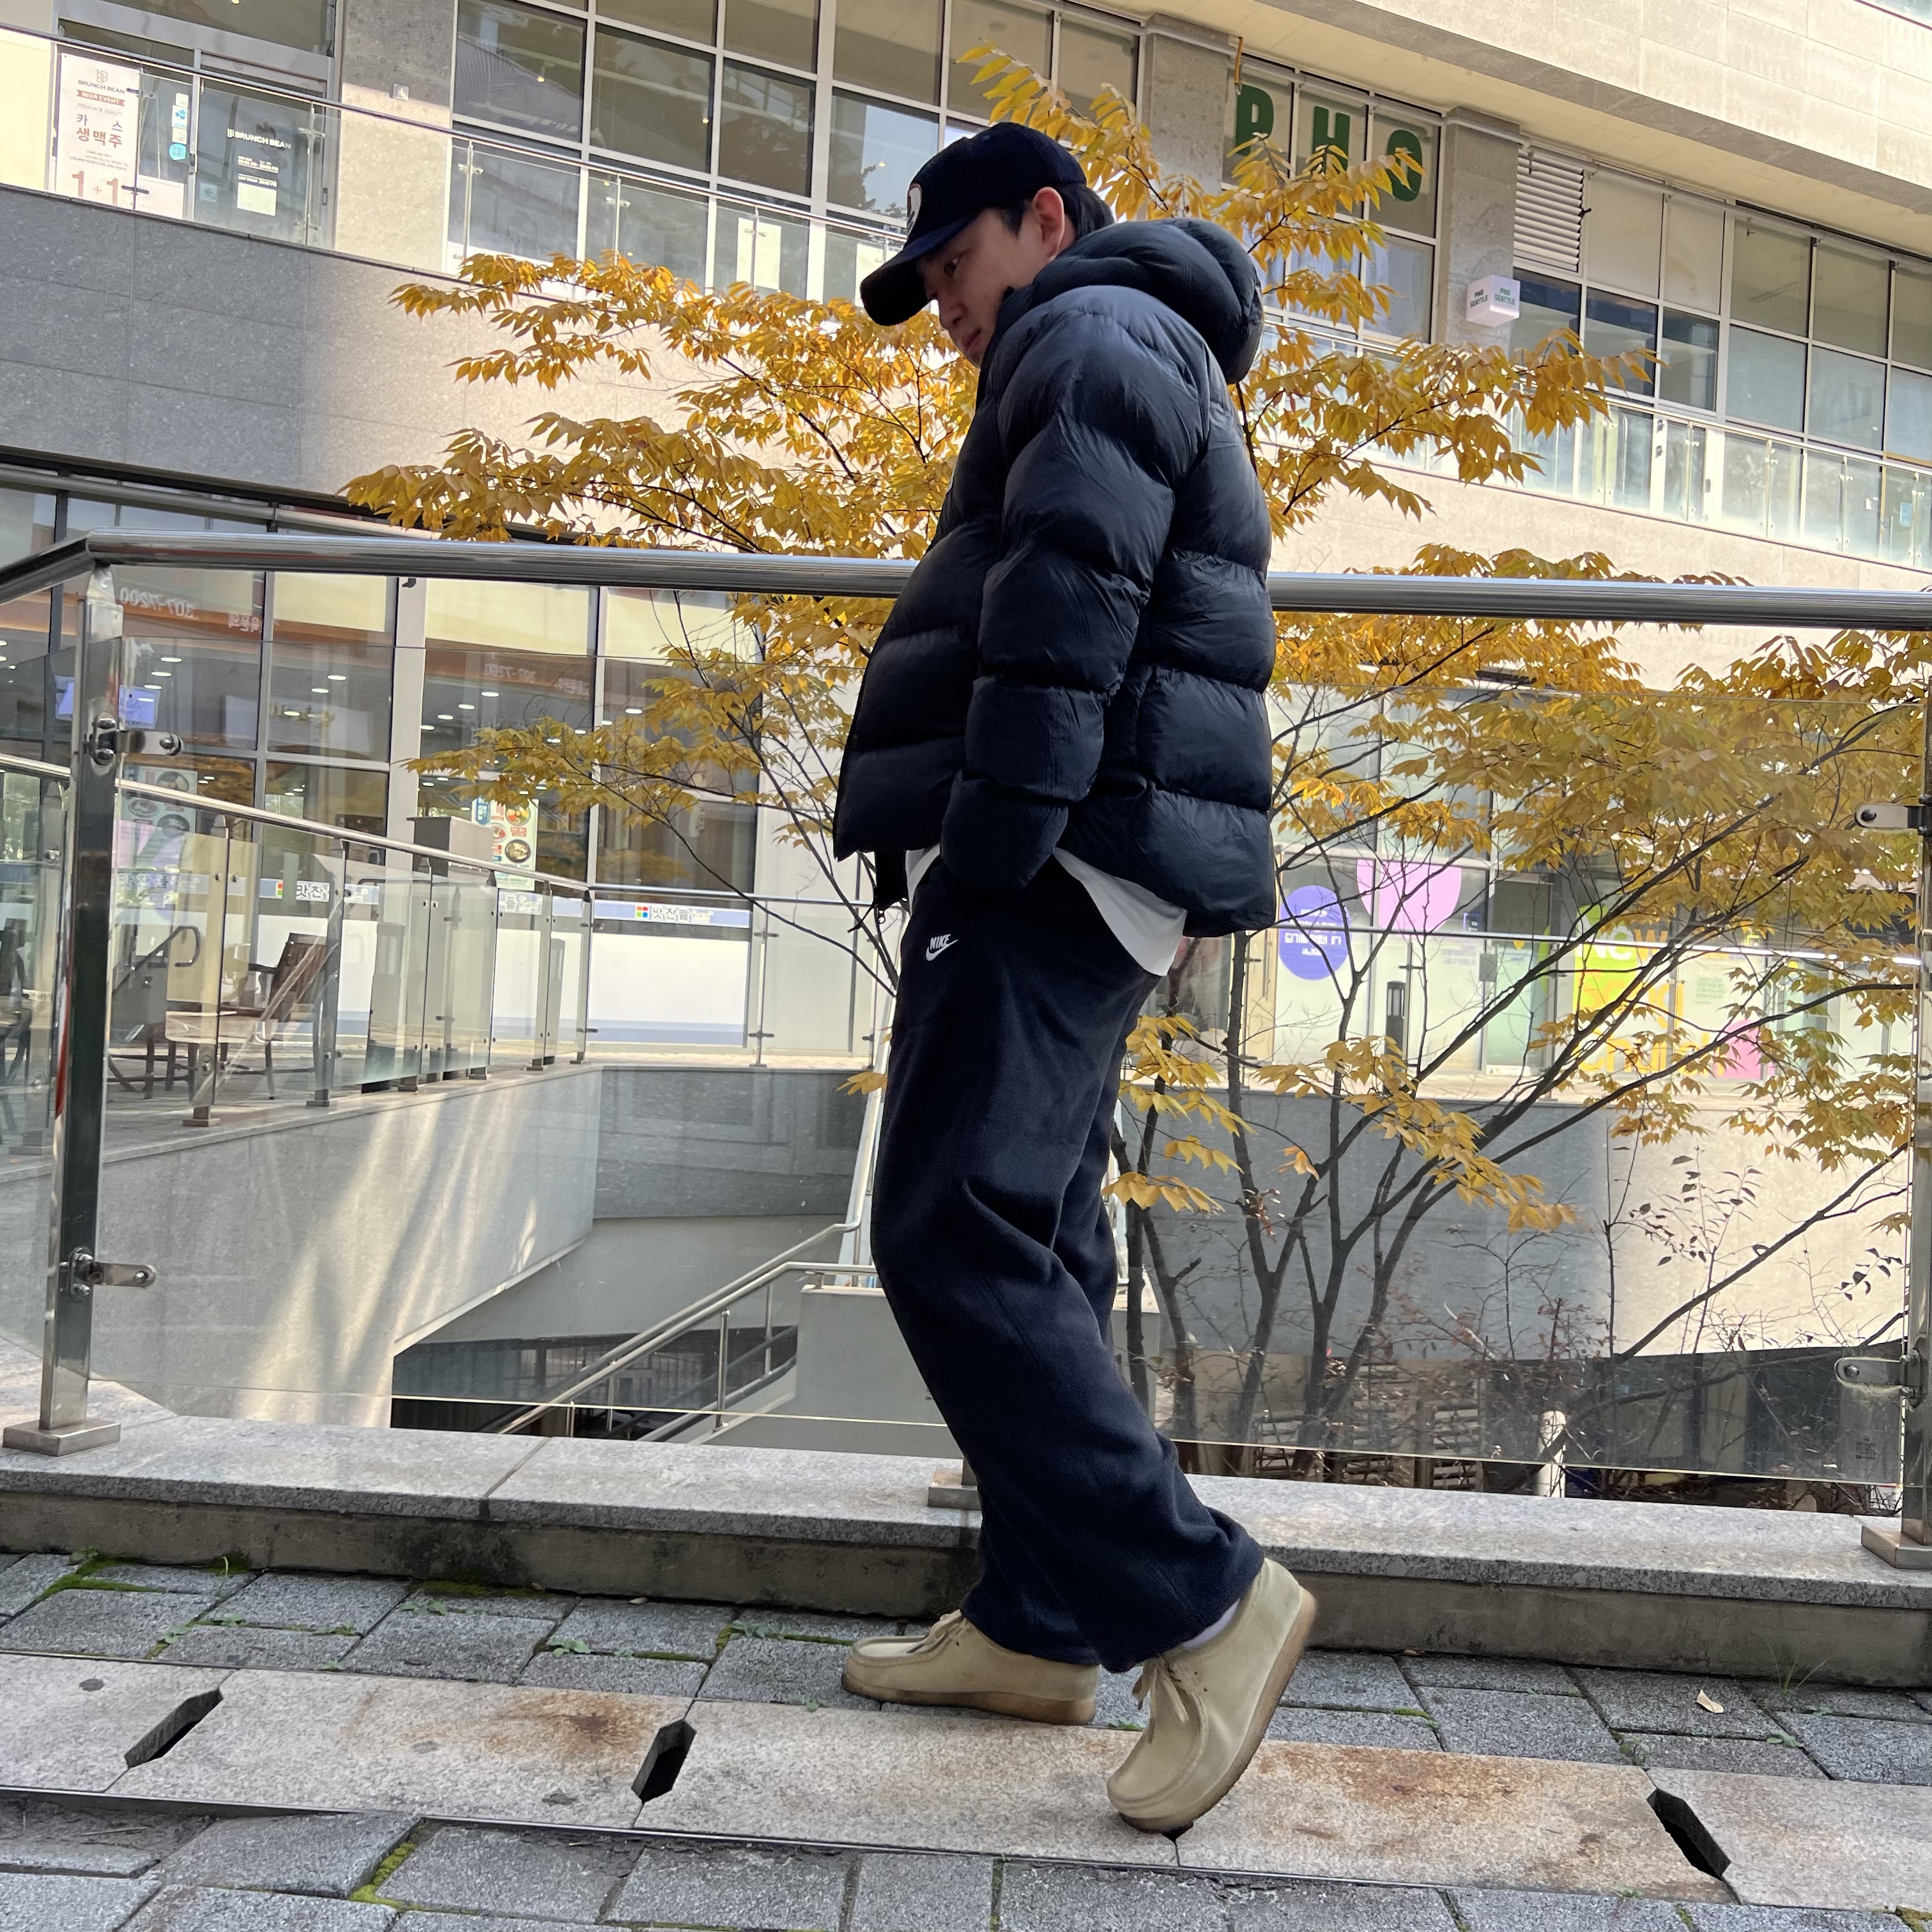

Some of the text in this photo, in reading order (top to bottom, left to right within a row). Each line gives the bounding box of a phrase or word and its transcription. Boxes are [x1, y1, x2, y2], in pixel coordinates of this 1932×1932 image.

[78, 80, 106, 90] BRUNCH
[82, 91, 120, 105] BEER EVENT
[76, 127, 123, 148] 생맥주
[234, 131, 291, 150] BRUNCH BEAN
[1234, 84, 1423, 202] PHO
[72, 170, 119, 206] 1+1
[1470, 295, 1488, 308] SEATTLE
[1495, 294, 1515, 305] SEATTLE
[930, 933, 951, 951] NIKE
